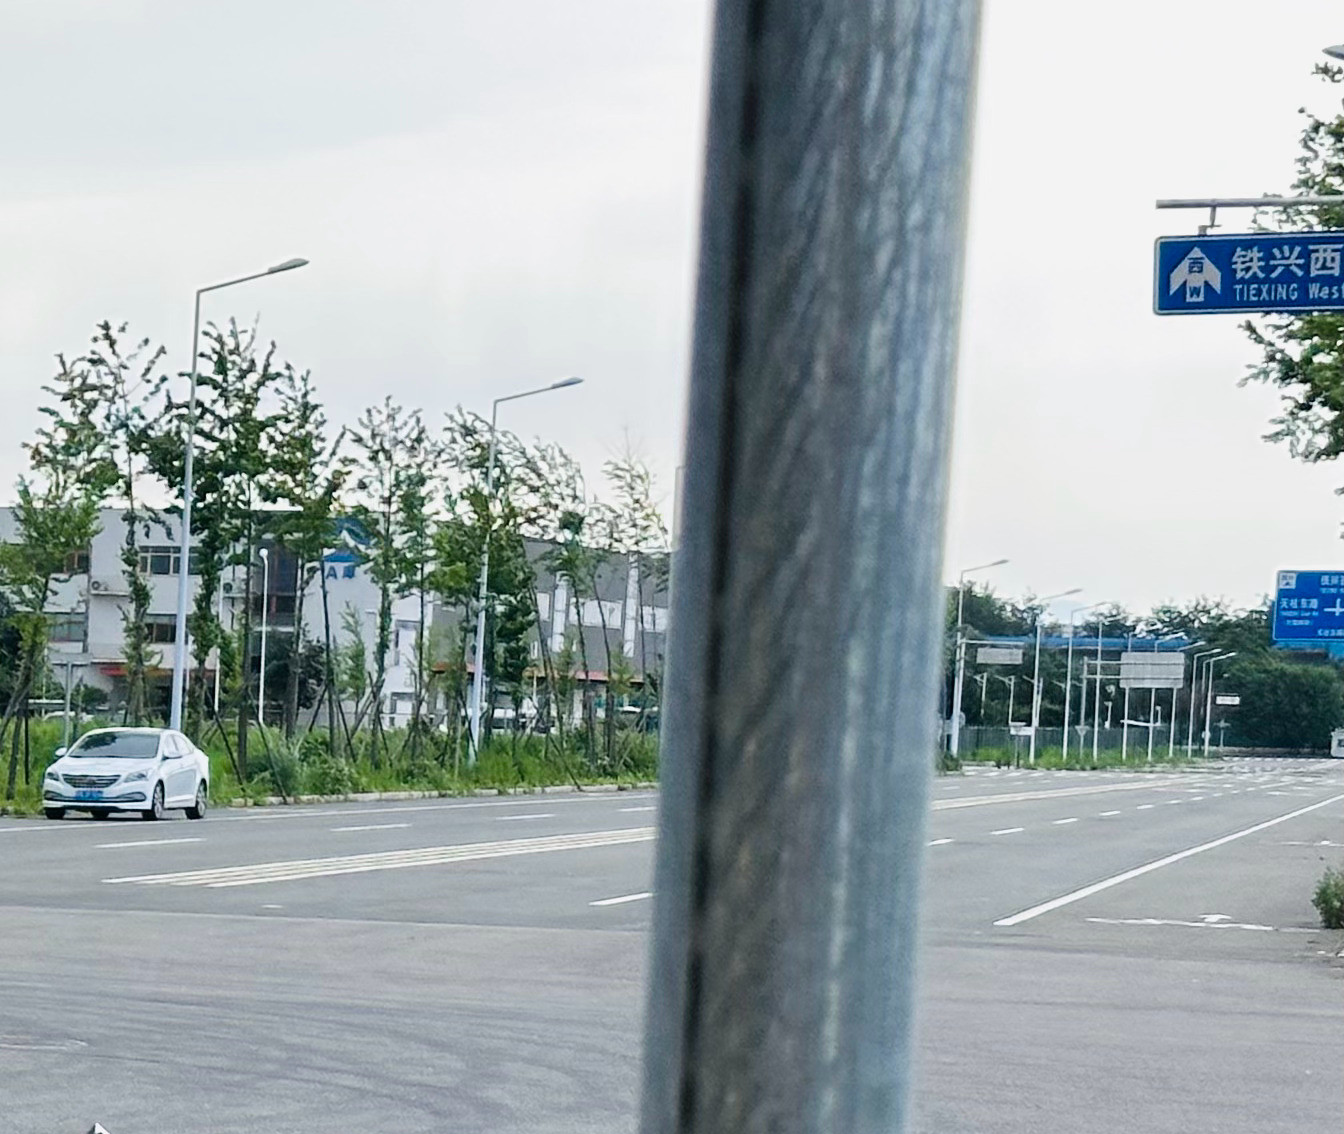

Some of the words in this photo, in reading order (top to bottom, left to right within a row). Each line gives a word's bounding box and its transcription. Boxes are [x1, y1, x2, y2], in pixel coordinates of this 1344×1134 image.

[1188, 257, 1205, 274] 西
[1231, 244, 1343, 280] 铁兴西
[1189, 285, 1202, 299] W
[1234, 282, 1298, 301] TIEXING
